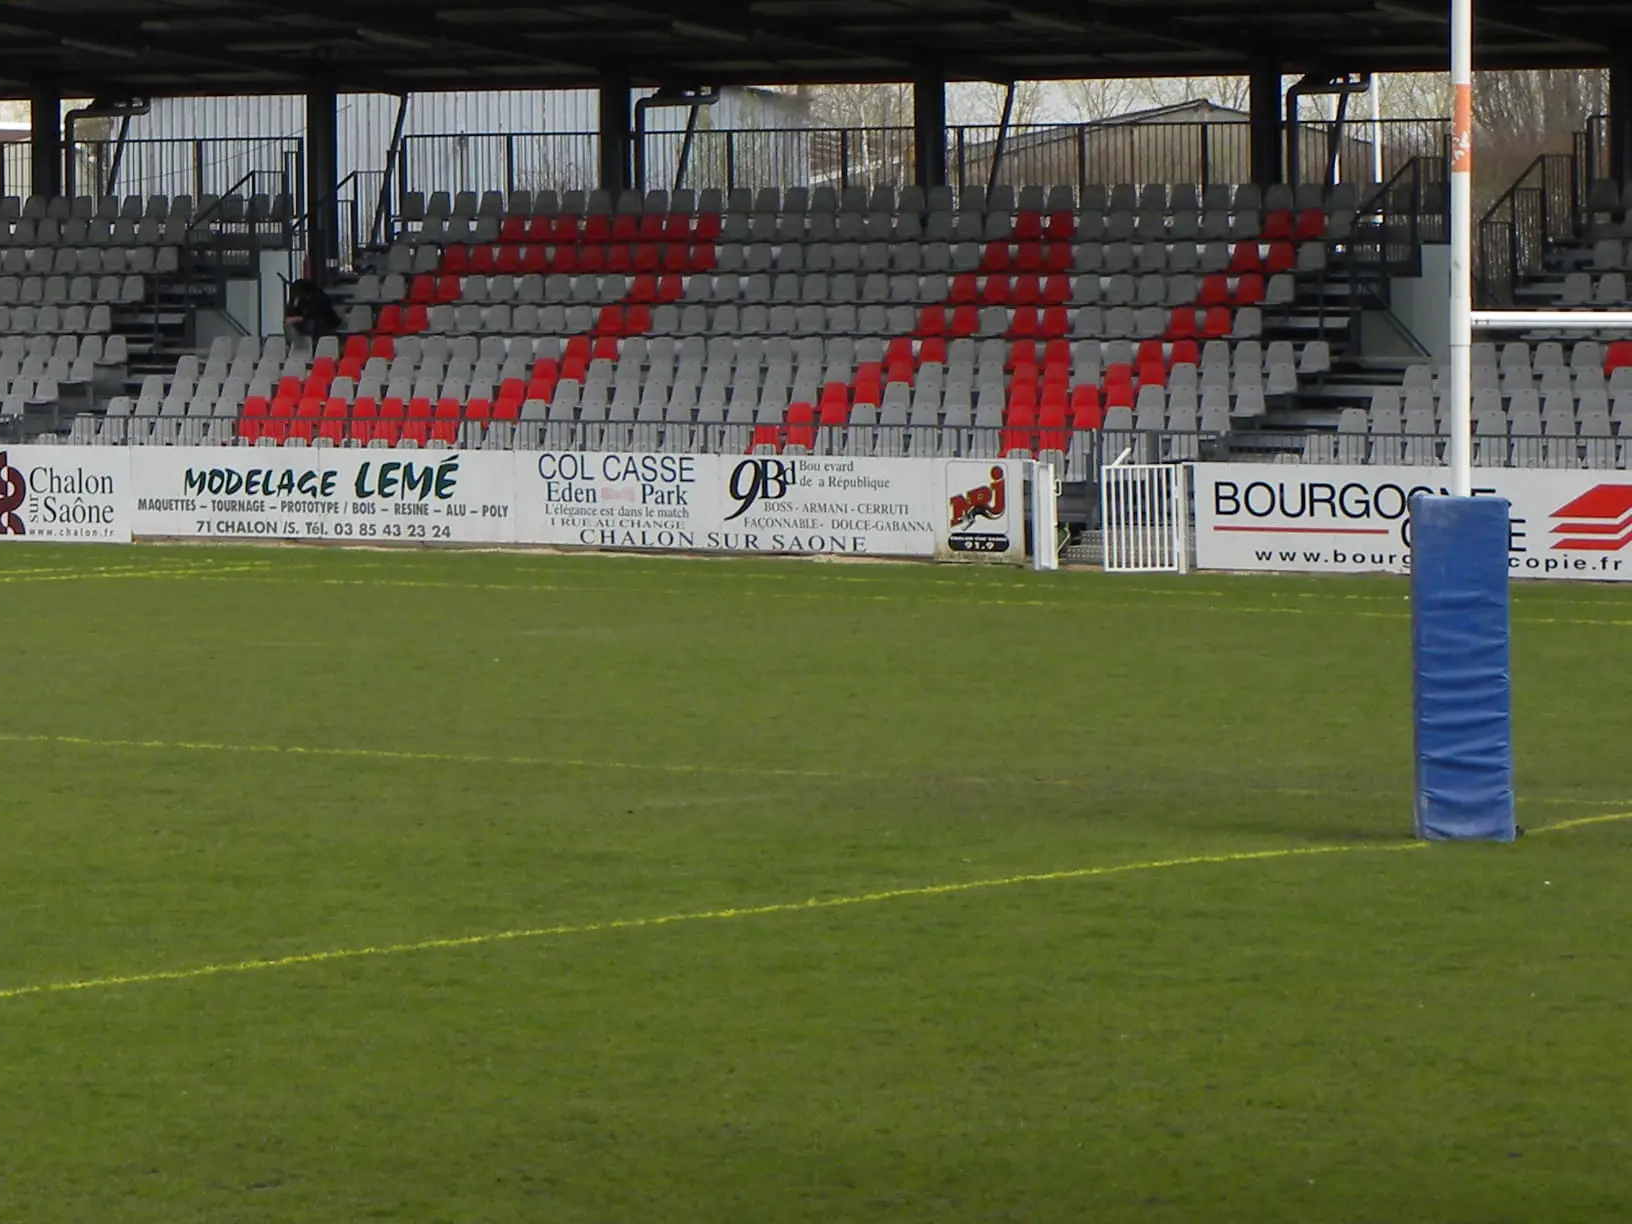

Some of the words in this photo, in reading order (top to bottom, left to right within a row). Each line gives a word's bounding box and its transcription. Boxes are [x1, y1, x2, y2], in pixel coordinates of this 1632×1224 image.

[538, 453, 595, 481] COL
[602, 454, 696, 483] CASSE
[799, 460, 854, 472] Bouevard
[29, 466, 113, 494] Chalon
[184, 468, 338, 498] MODELAGE
[354, 454, 459, 502] LEMÉ
[799, 475, 812, 487] de
[828, 476, 890, 490] République
[547, 481, 597, 503] Eden
[641, 483, 688, 505] Park
[1214, 481, 1496, 519] BOURGO
[29, 493, 39, 523] sur
[43, 496, 114, 524] Saône
[138, 498, 196, 512] MAQUETTES
[211, 499, 266, 513] TOURNAGE
[280, 500, 340, 515] PROTOTYPE
[352, 501, 377, 515] BOIS
[394, 503, 430, 516] RESINE
[446, 504, 467, 517] ALU
[482, 504, 509, 518] POLY
[599, 507, 614, 517] est
[618, 506, 642, 518] dans
[645, 506, 655, 518] le
[657, 507, 689, 519] match
[764, 502, 793, 512] BOSS
[802, 503, 848, 514] ARMANI
[857, 504, 909, 515] CERRUTI
[29, 528, 114, 537] www.chalon.fr
[196, 521, 212, 533] 71
[216, 520, 277, 534] CHALON
[305, 522, 328, 536] Tél.
[334, 523, 353, 537] 03
[359, 524, 377, 537] 85
[382, 524, 402, 537] 43
[407, 524, 426, 538] 23
[431, 525, 451, 538] 24
[560, 518, 590, 526] RUE
[597, 520, 615, 528] AU
[619, 520, 685, 530] CHANGE
[580, 529, 693, 546] CHALON
[707, 532, 759, 549] SUR
